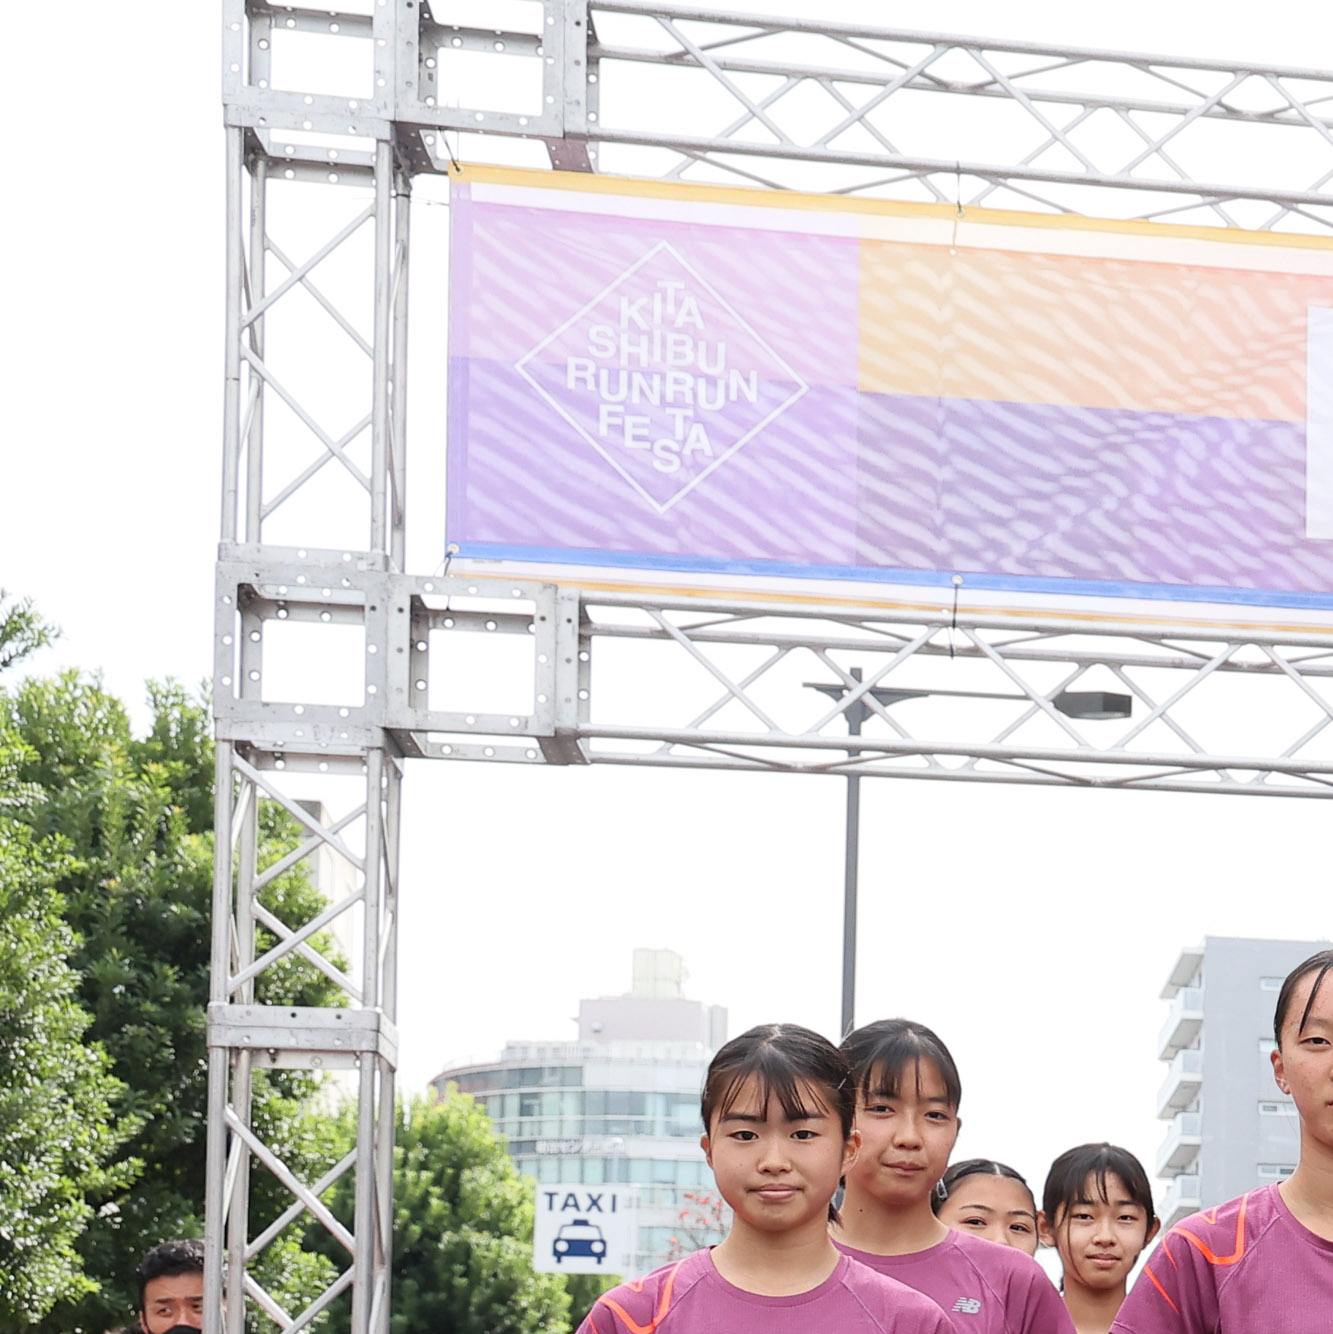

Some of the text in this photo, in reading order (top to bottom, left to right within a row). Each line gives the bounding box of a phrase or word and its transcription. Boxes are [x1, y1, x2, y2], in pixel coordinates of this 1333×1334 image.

[620, 280, 705, 330] KITA
[587, 324, 727, 375] SHIBU
[566, 356, 759, 411] RUNRUN
[599, 403, 714, 474] FESTA
[544, 1191, 618, 1213] TAXI
